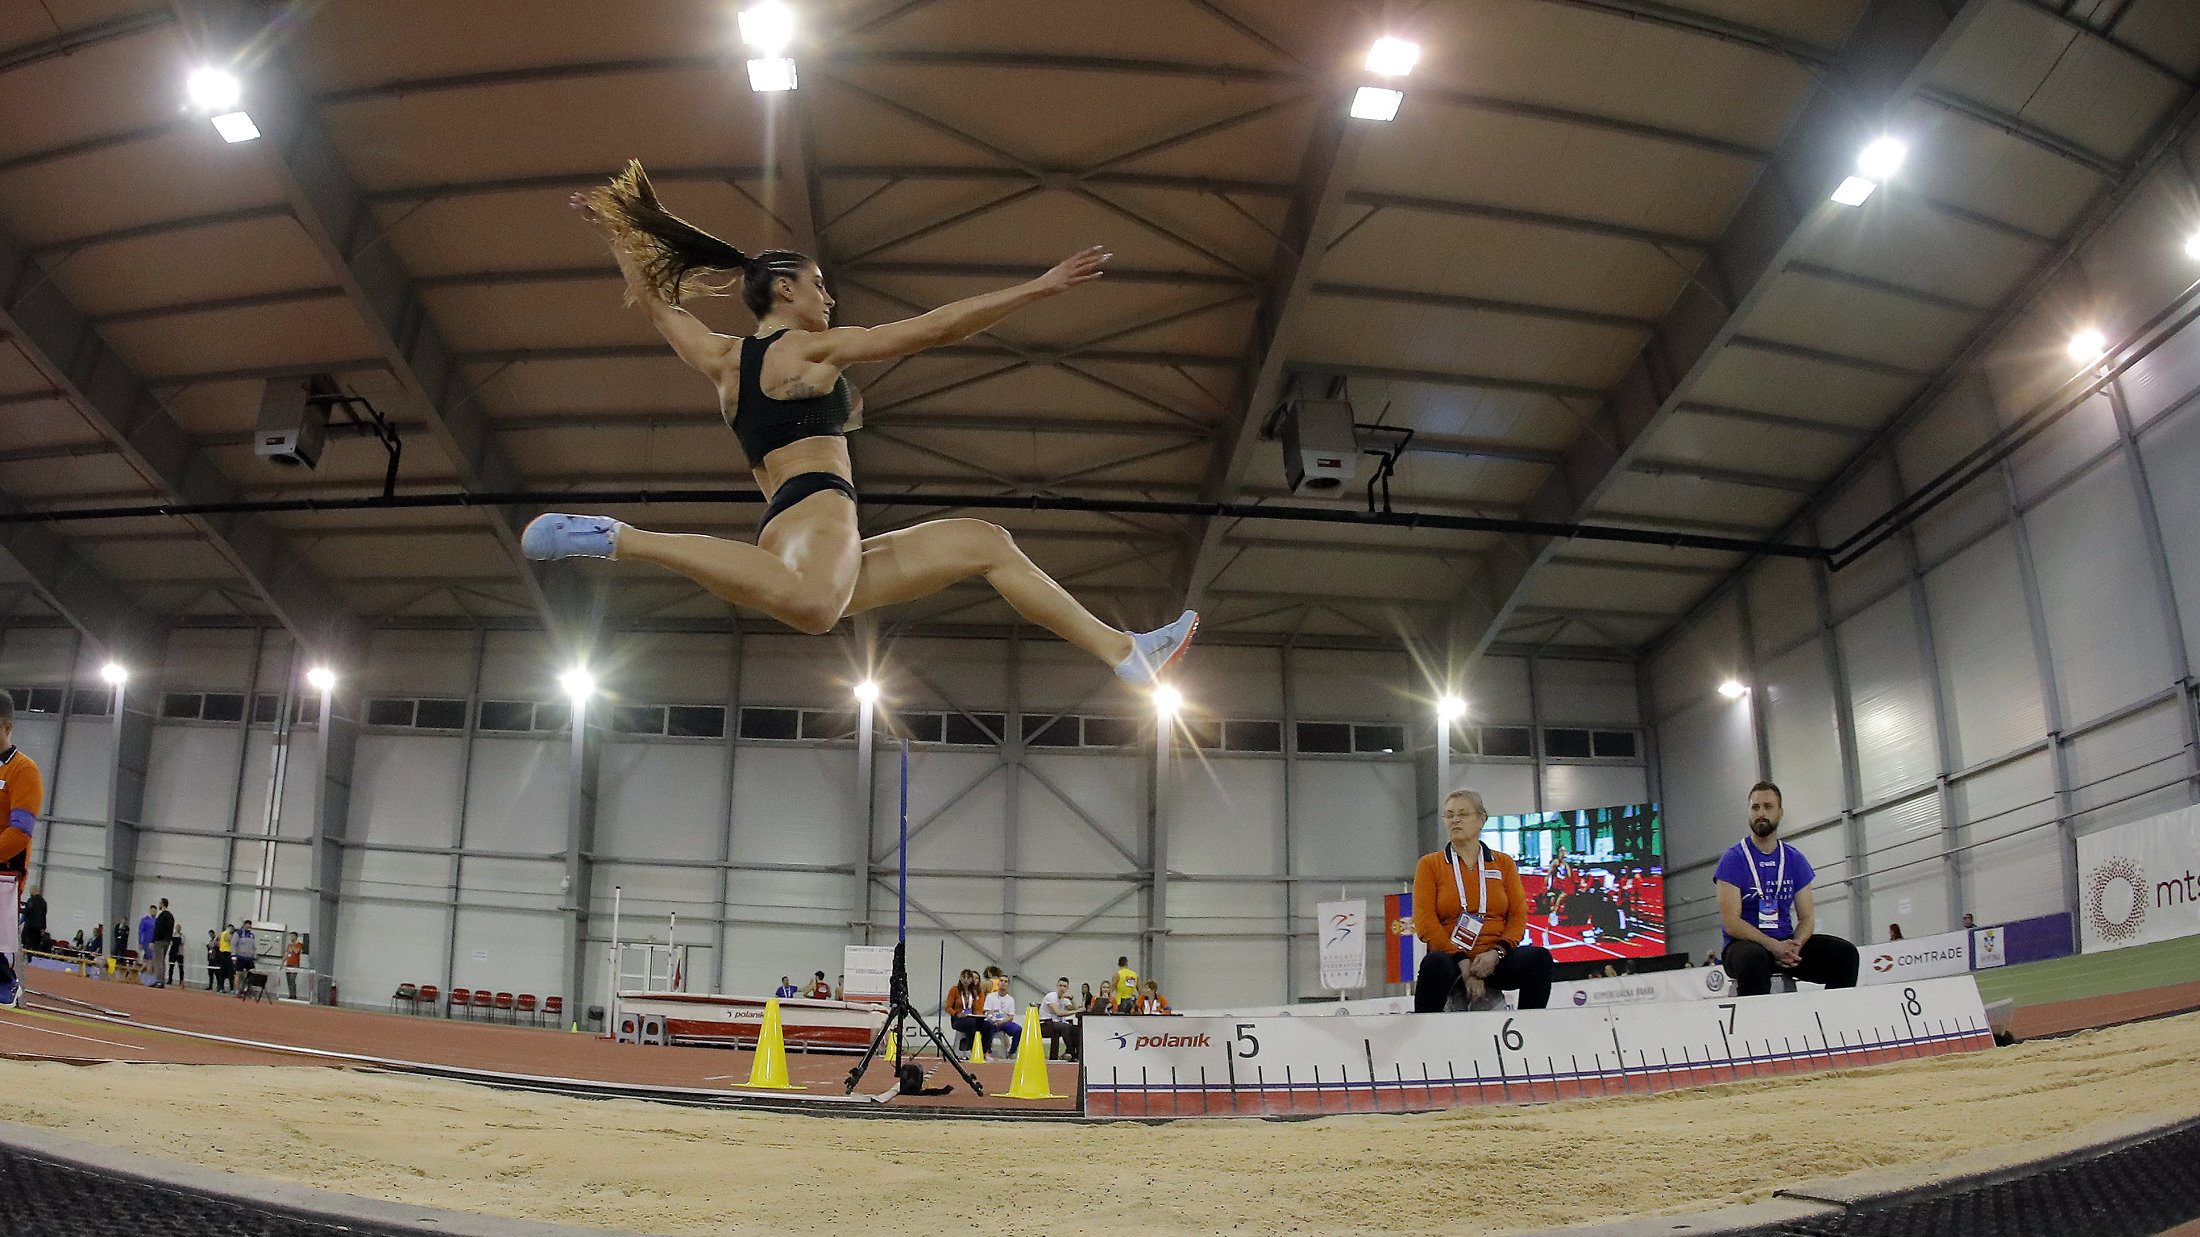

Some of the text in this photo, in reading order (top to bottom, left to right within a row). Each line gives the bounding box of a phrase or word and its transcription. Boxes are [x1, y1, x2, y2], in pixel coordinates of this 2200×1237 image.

[2156, 869, 2200, 907] mt
[1897, 946, 1963, 966] COMTRADE
[1904, 987, 1921, 1016] 8
[1502, 1017, 1524, 1051] 6
[1718, 1003, 1736, 1035] 7
[1134, 1032, 1211, 1051] polanik
[1236, 1024, 1260, 1059] 5
